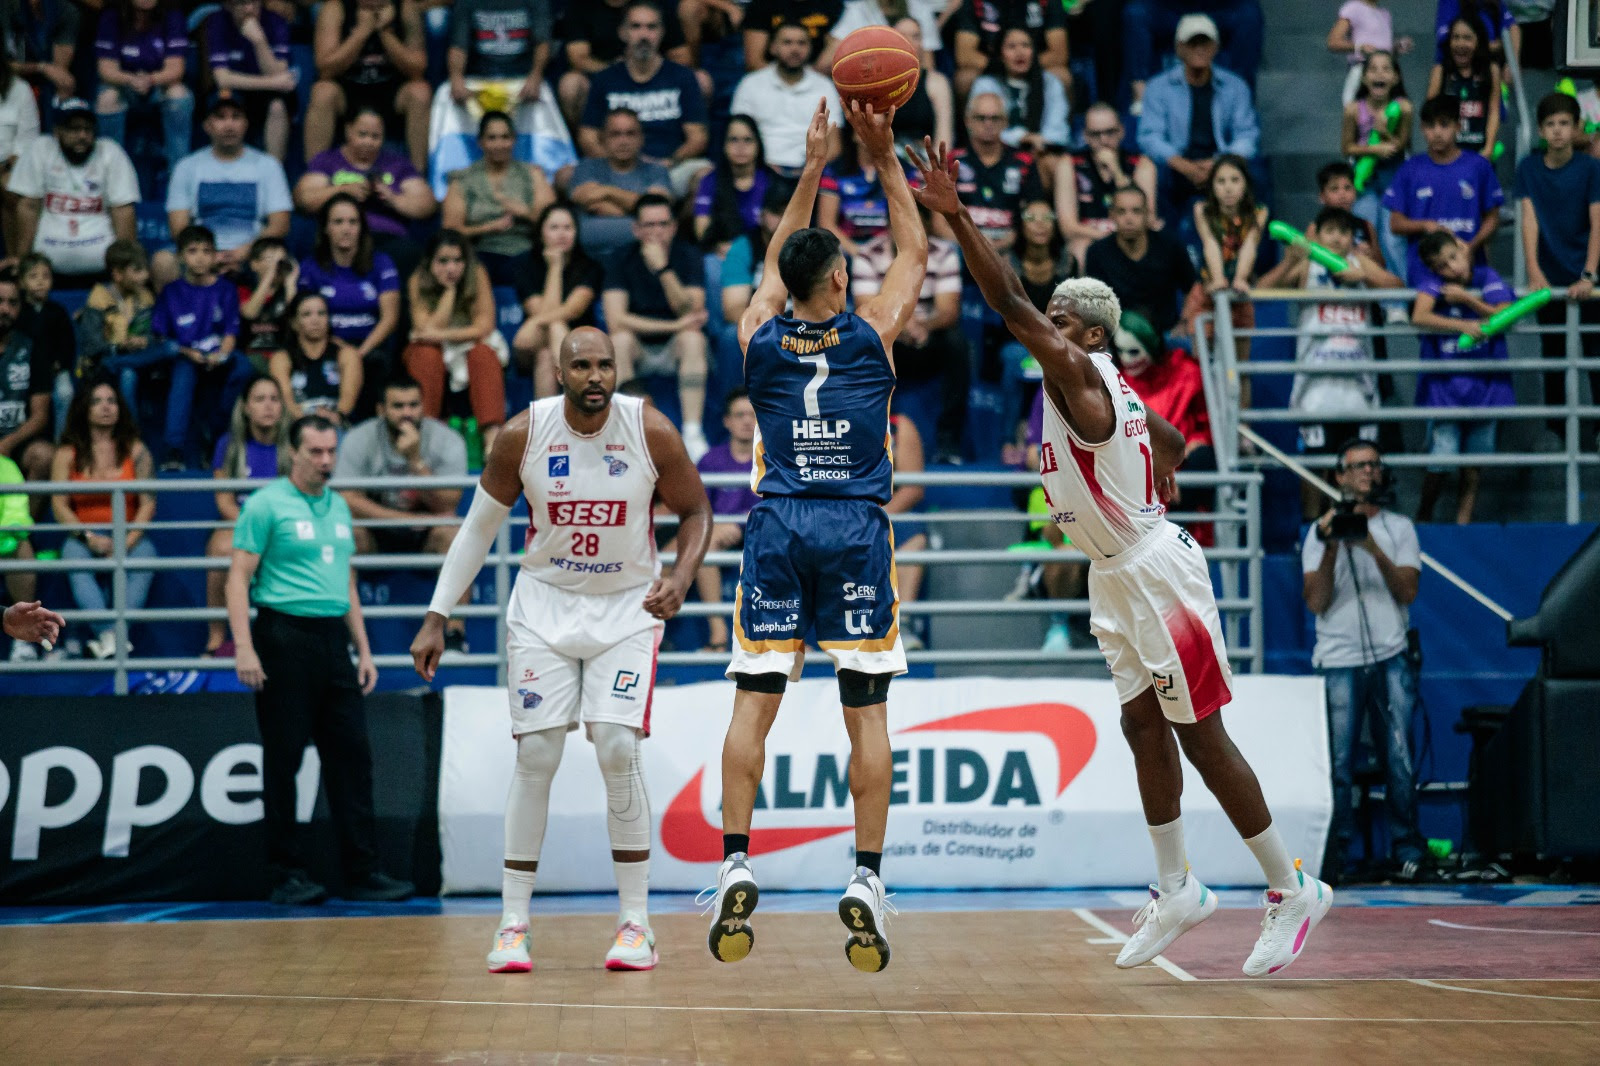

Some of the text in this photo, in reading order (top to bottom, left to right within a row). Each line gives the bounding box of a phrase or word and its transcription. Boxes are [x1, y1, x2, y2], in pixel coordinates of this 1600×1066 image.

[797, 353, 830, 419] 7
[792, 420, 851, 439] HELP
[809, 455, 852, 465] MEDCEL
[799, 467, 850, 481] SERCOSI
[556, 503, 620, 525] SESI
[571, 532, 600, 557] 28
[549, 557, 624, 574] NETSHOES
[0, 743, 321, 860] pper
[922, 818, 1039, 838] Distribuidor de
[921, 841, 941, 856] de
[945, 840, 1036, 862] Construção
